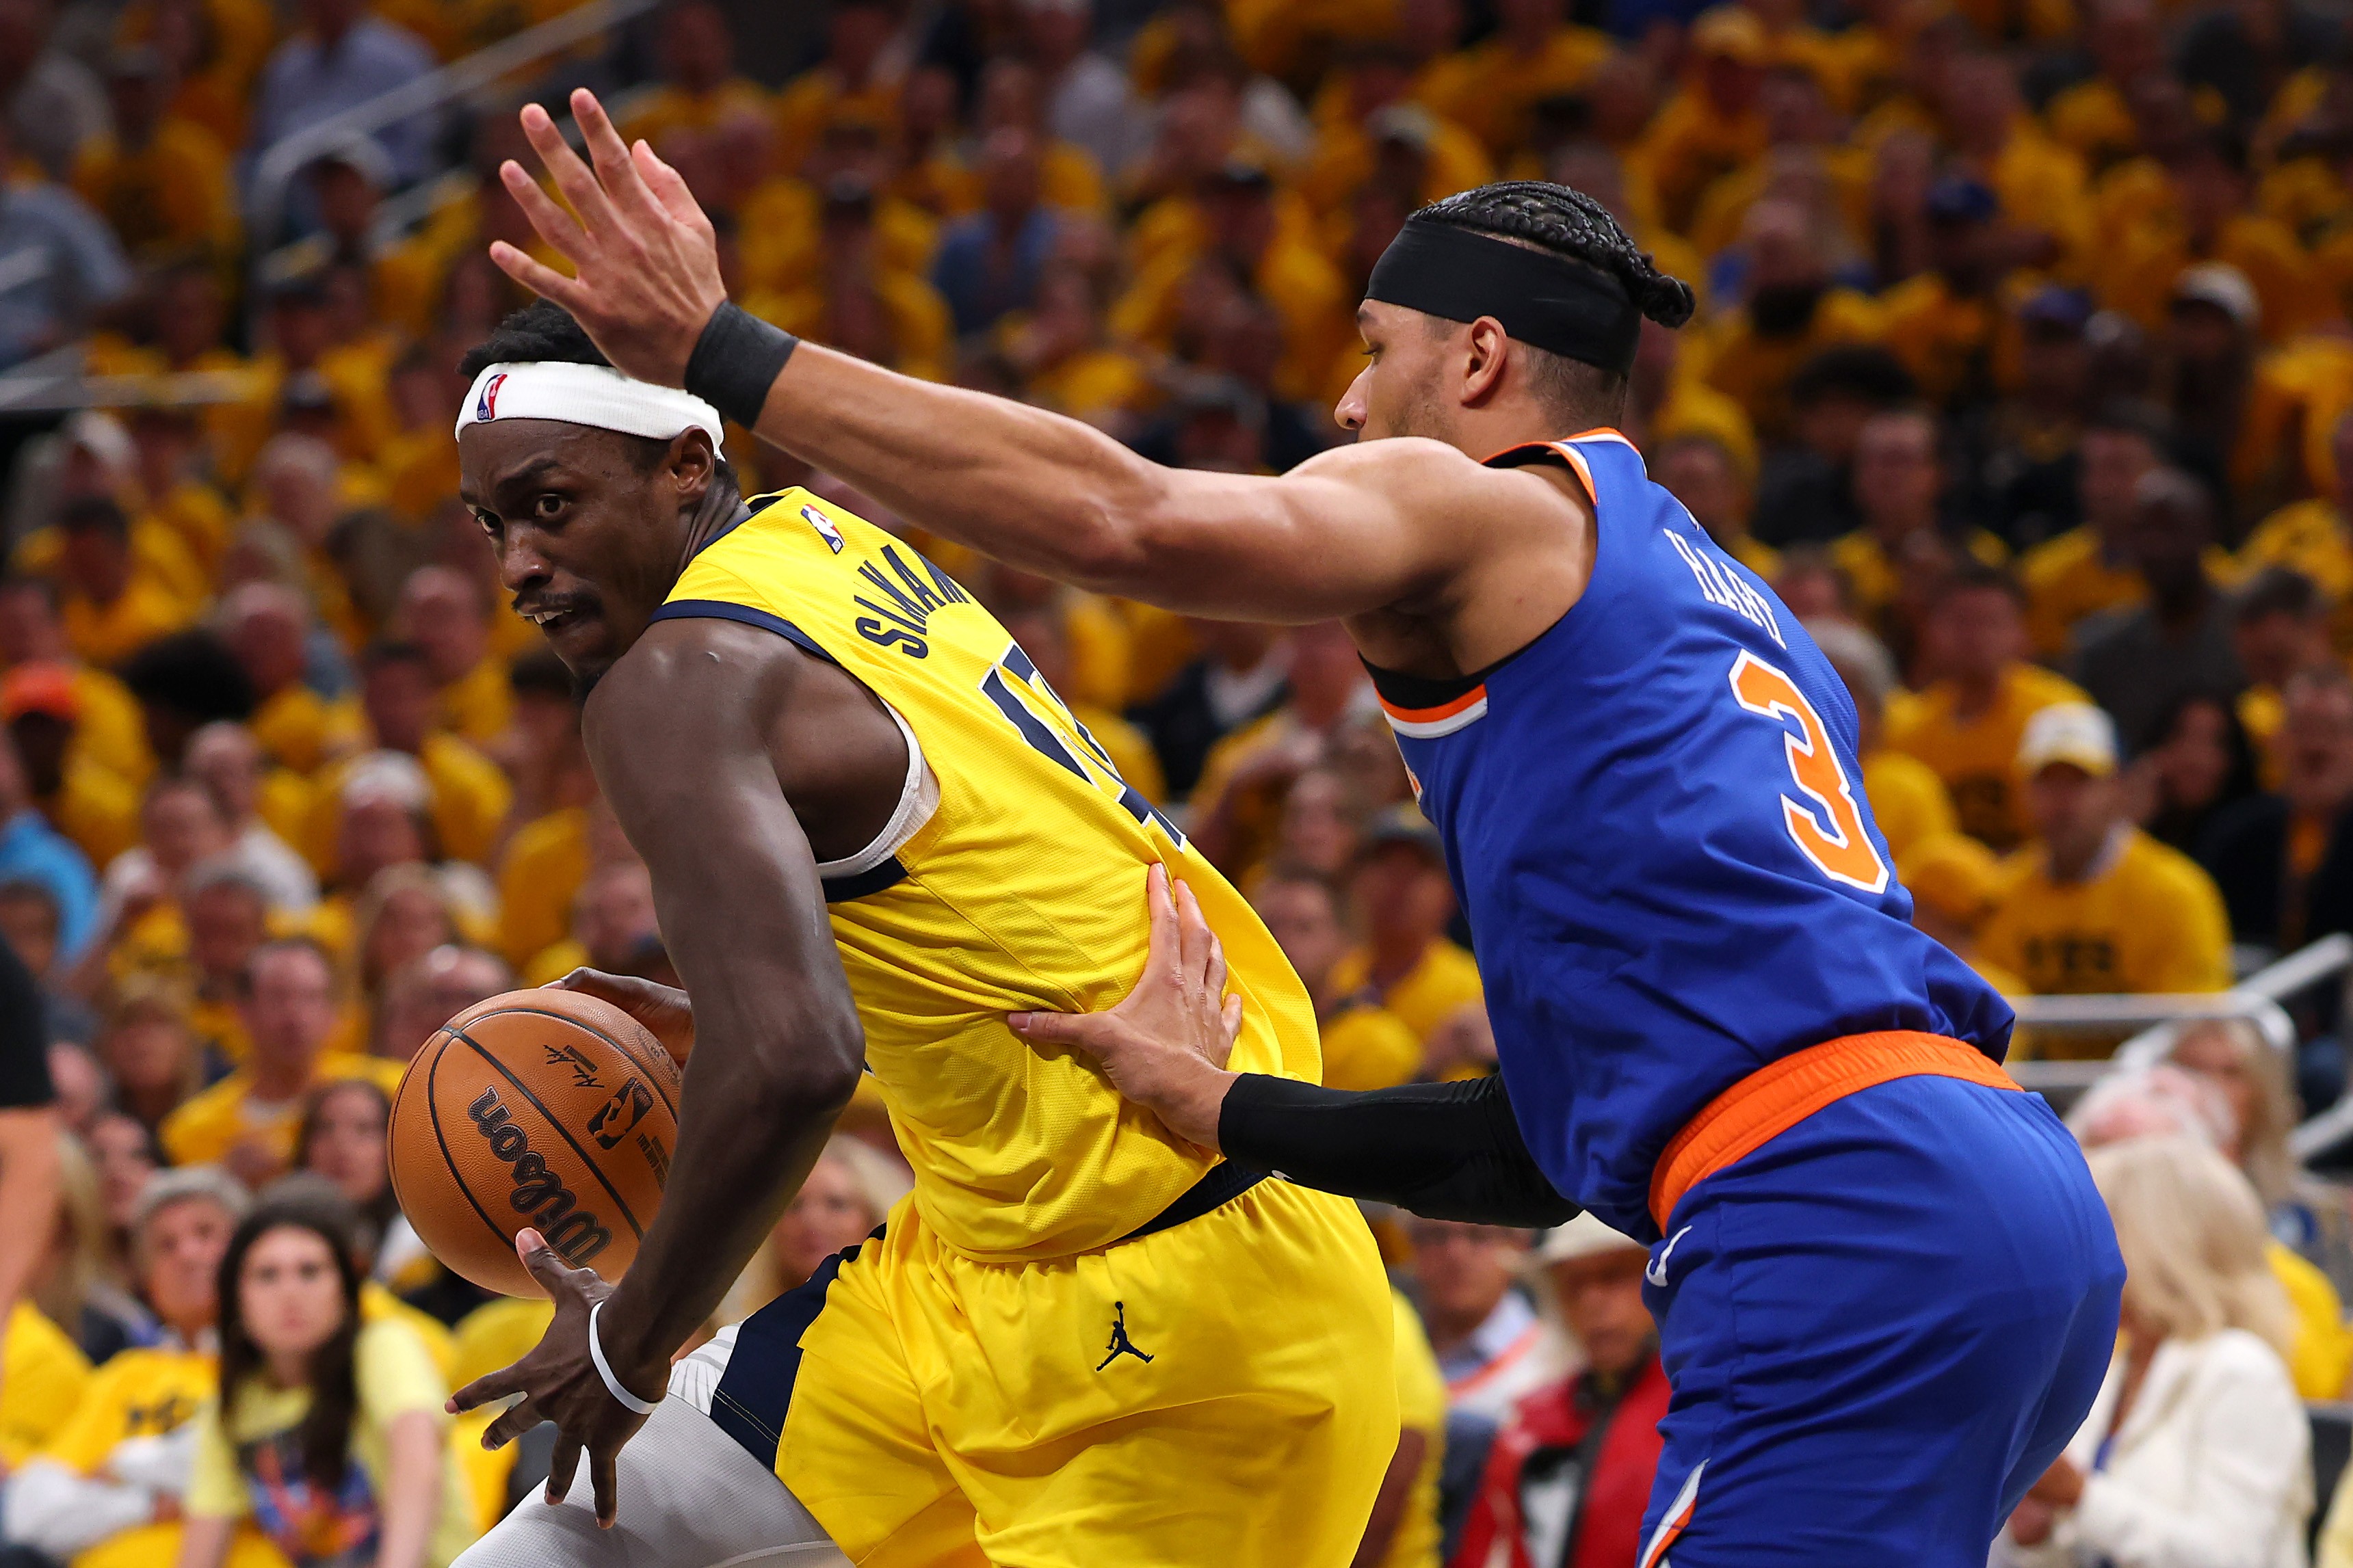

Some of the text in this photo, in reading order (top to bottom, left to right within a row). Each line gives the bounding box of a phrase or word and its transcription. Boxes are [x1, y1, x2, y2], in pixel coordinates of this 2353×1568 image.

[1663, 527, 1787, 650] HART
[1728, 648, 1890, 894] 3
[468, 1085, 613, 1272] Wilson
